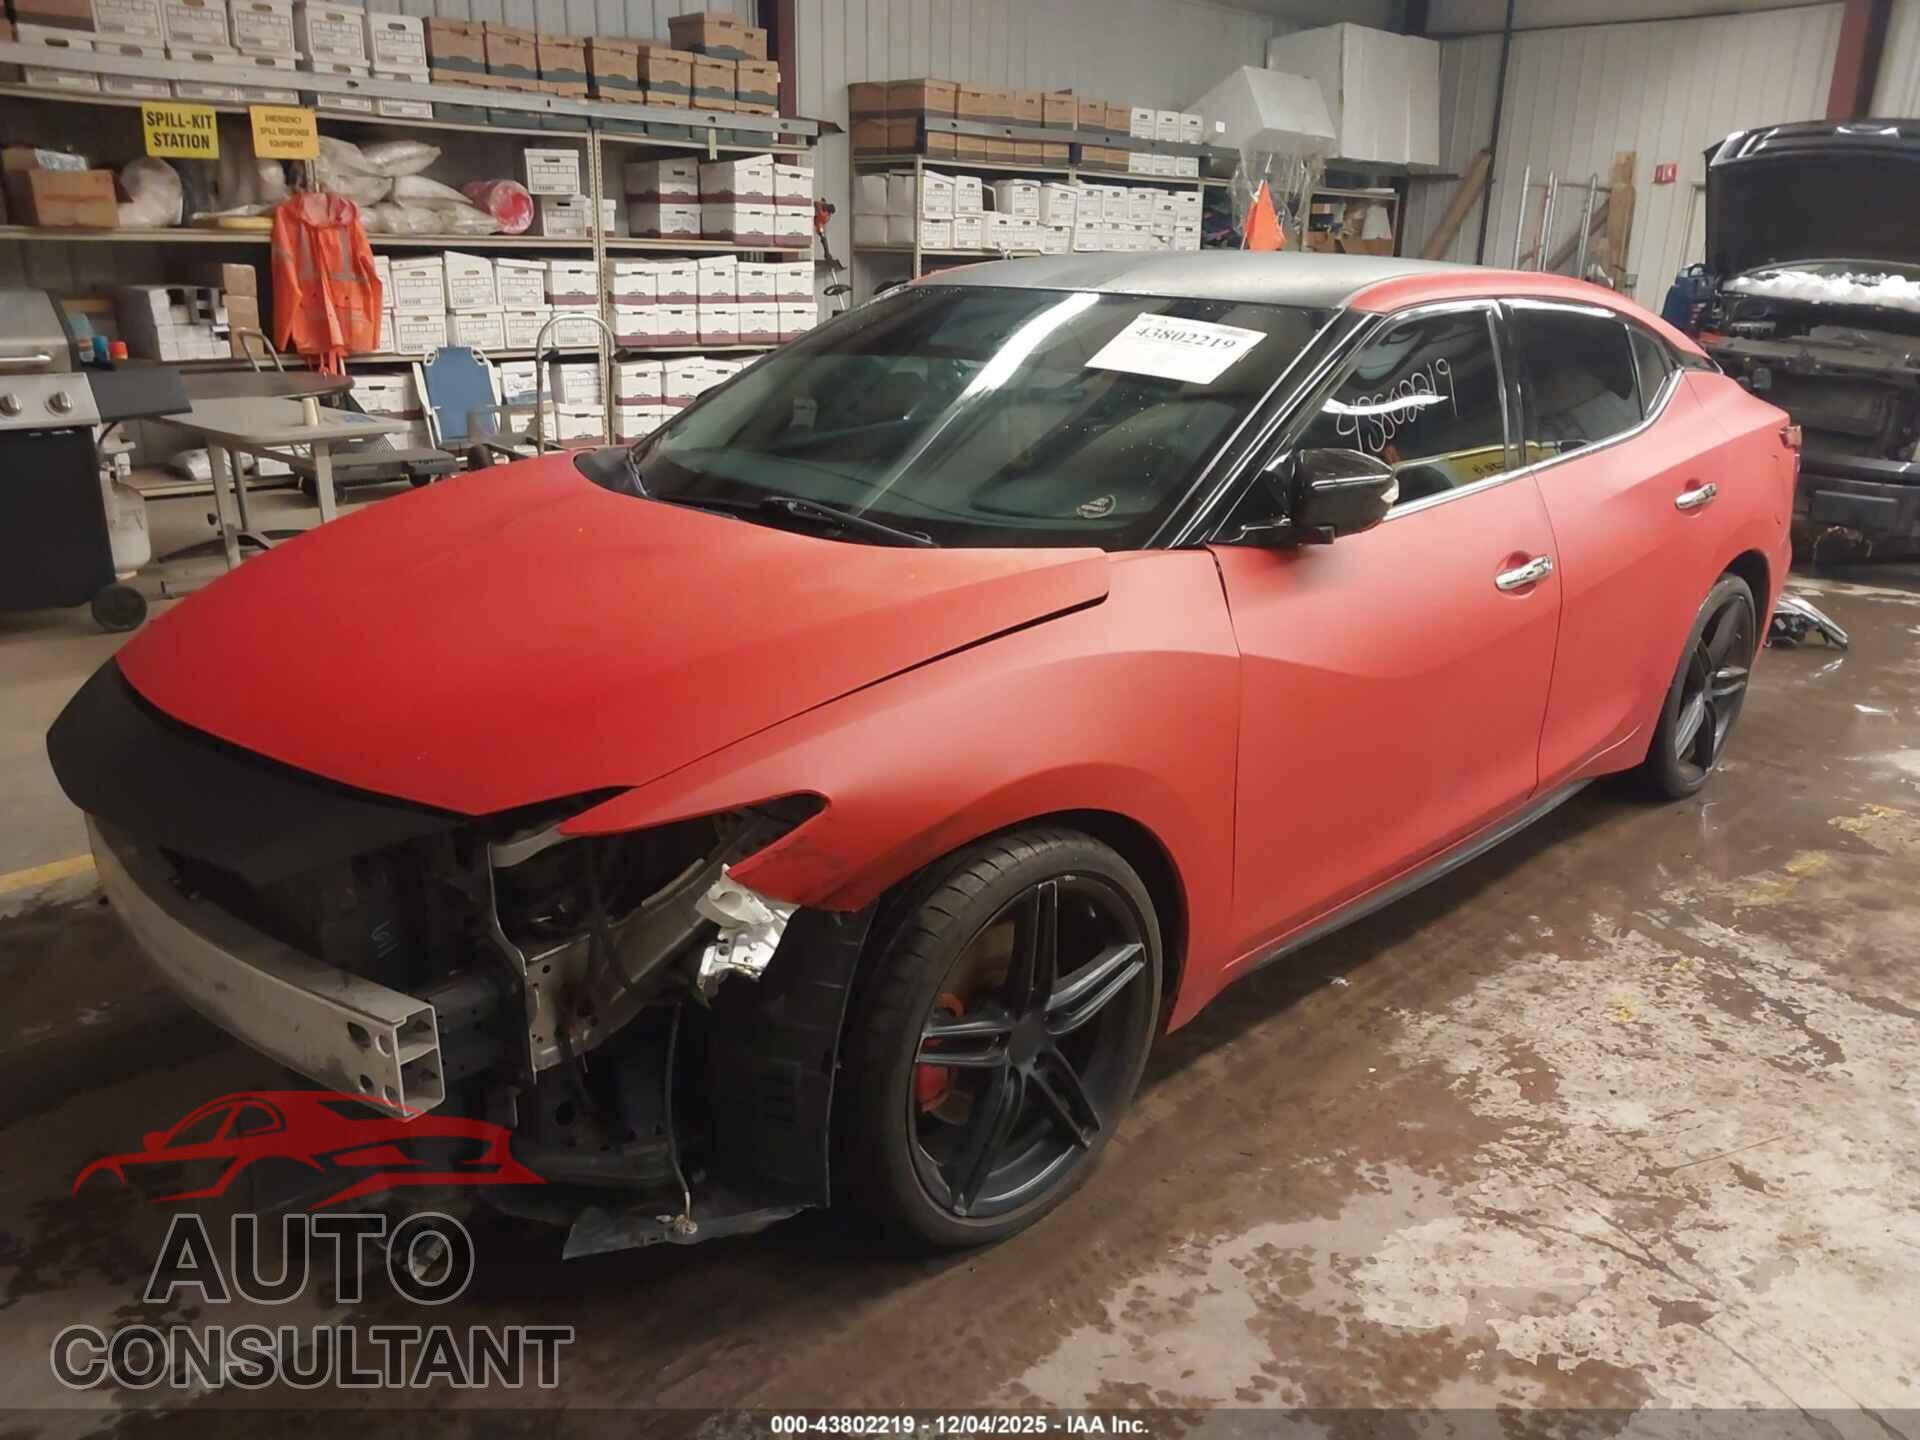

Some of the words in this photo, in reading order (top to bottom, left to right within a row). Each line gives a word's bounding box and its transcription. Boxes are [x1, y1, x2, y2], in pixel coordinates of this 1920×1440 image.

[146, 111, 213, 129] SPILL-KIT
[153, 131, 210, 149] STATION
[1136, 327, 1237, 348] 43802219
